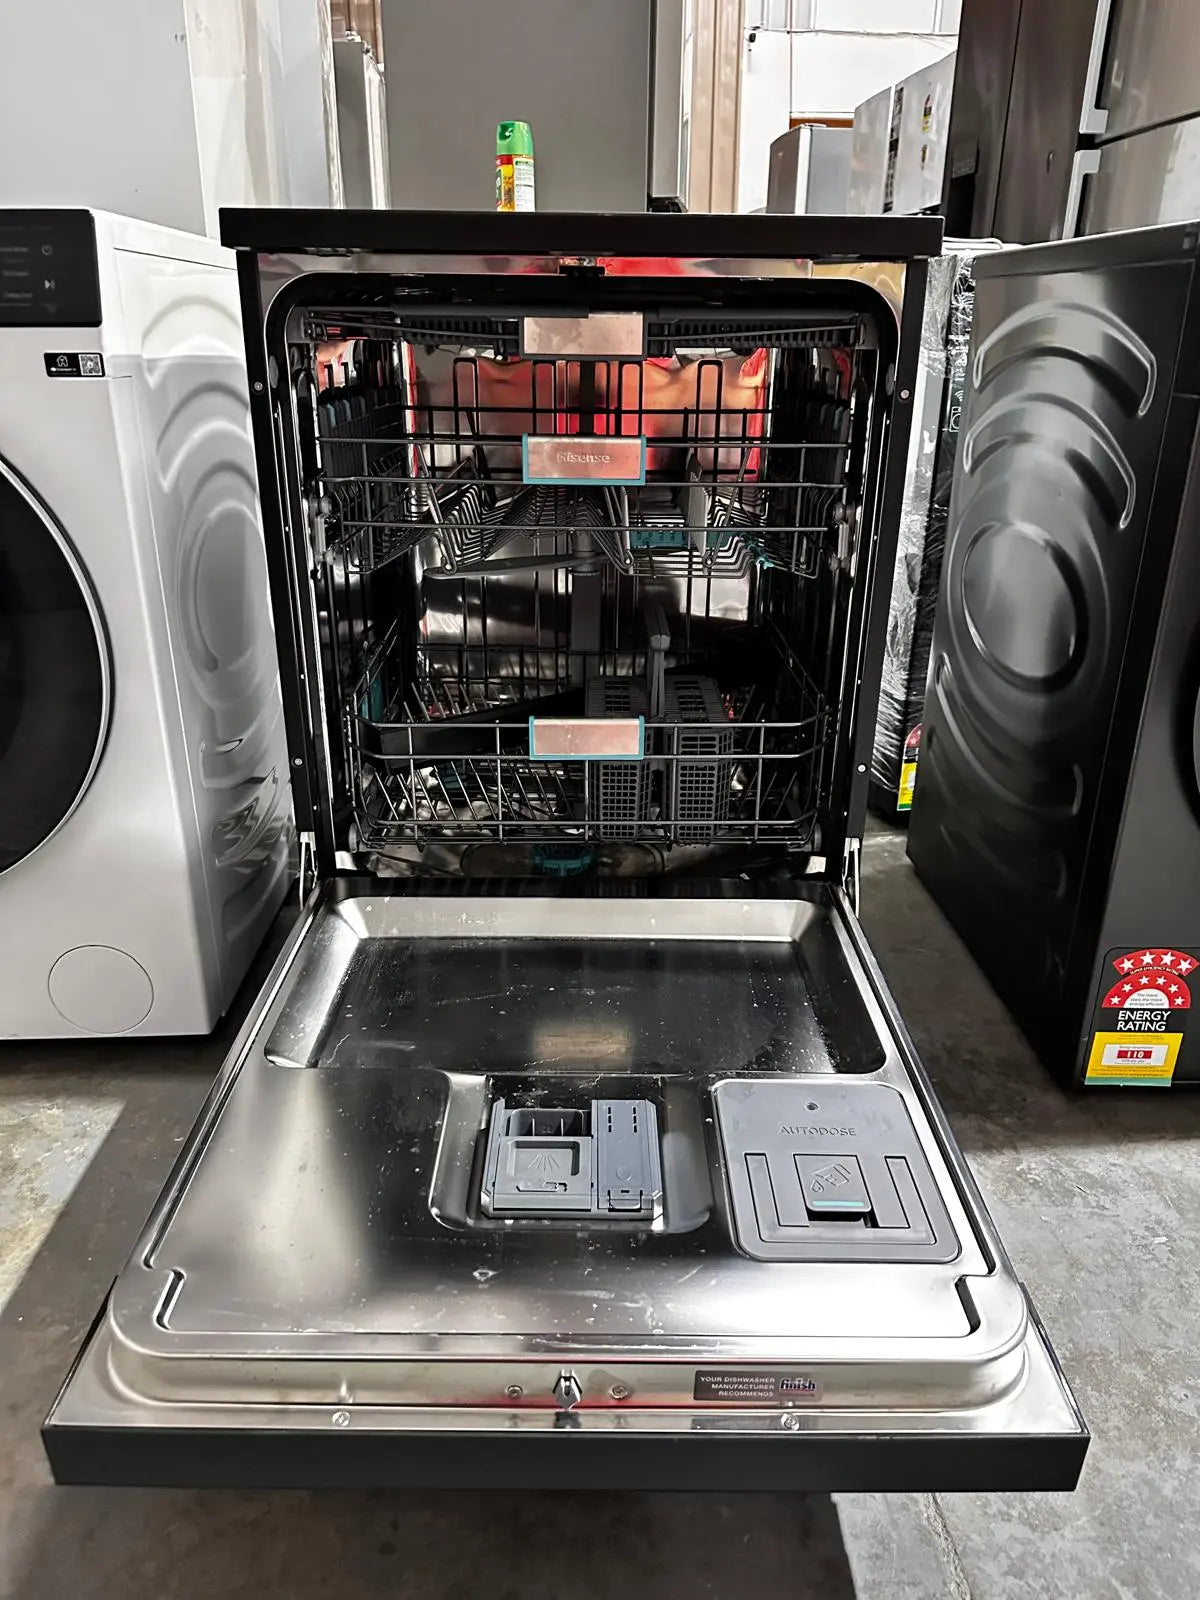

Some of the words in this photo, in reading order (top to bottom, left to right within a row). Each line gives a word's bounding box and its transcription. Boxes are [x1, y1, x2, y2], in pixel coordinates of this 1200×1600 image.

[1118, 1010, 1171, 1021] ENERGY
[1117, 1021, 1167, 1031] RATING
[780, 1126, 857, 1136] AUTODOSE
[779, 1376, 816, 1391] finish
